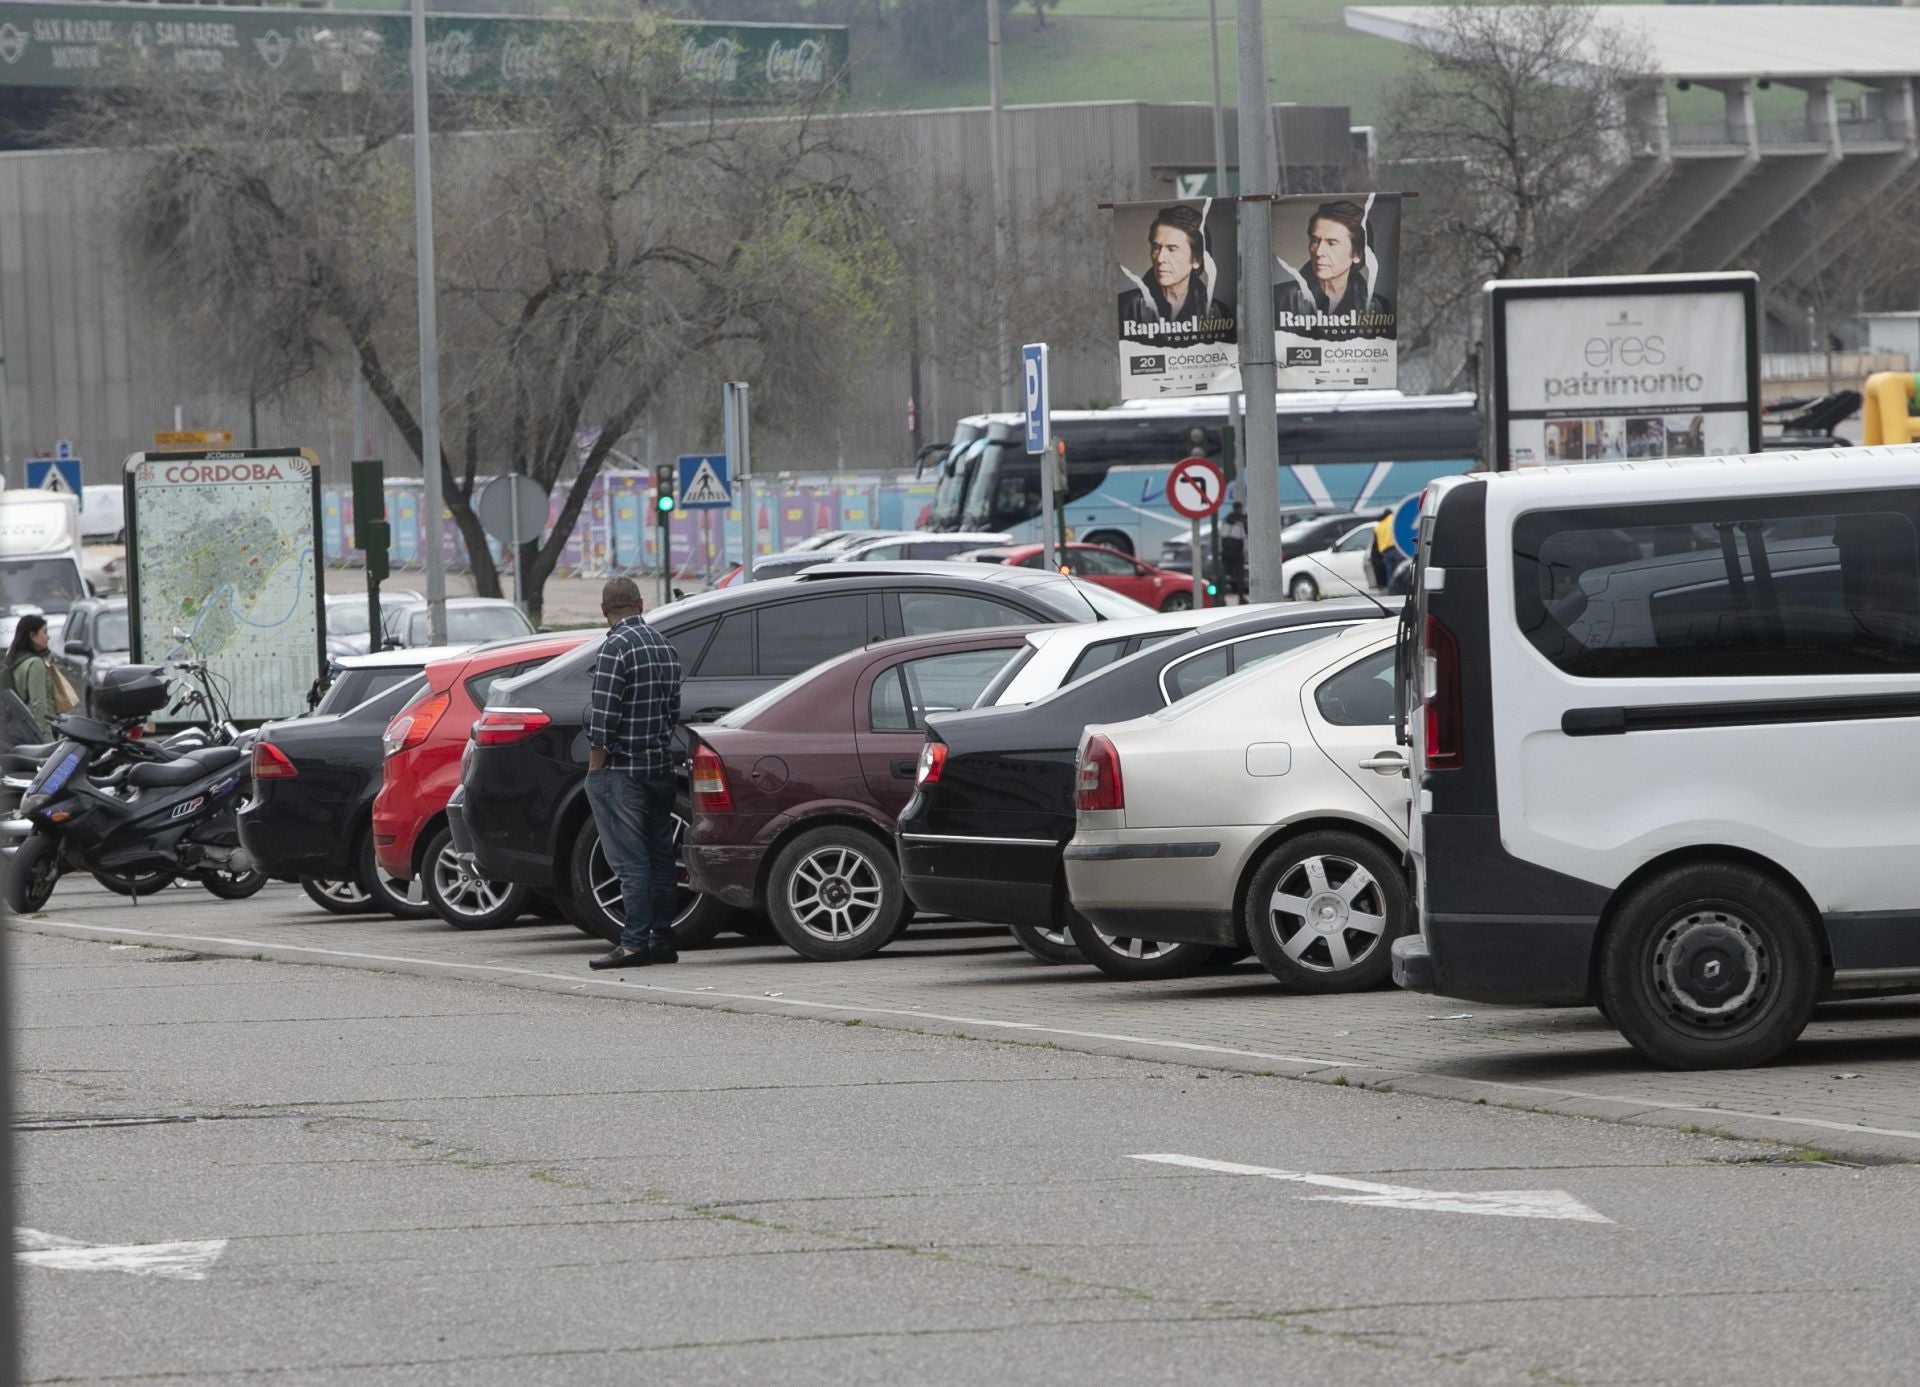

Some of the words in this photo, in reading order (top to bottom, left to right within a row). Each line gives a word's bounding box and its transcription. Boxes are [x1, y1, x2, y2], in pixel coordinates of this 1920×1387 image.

[1123, 315, 1234, 339] Raphaelísimo
[1280, 309, 1395, 331] Raphaelísimo
[1295, 349, 1312, 359] 20
[1584, 334, 1666, 367] eres
[1139, 357, 1156, 368] 20
[1544, 367, 1703, 403] patrimonio
[1025, 358, 1039, 440] P
[205, 451, 245, 460] JCDecaux
[165, 460, 284, 483] CÓRDOBA
